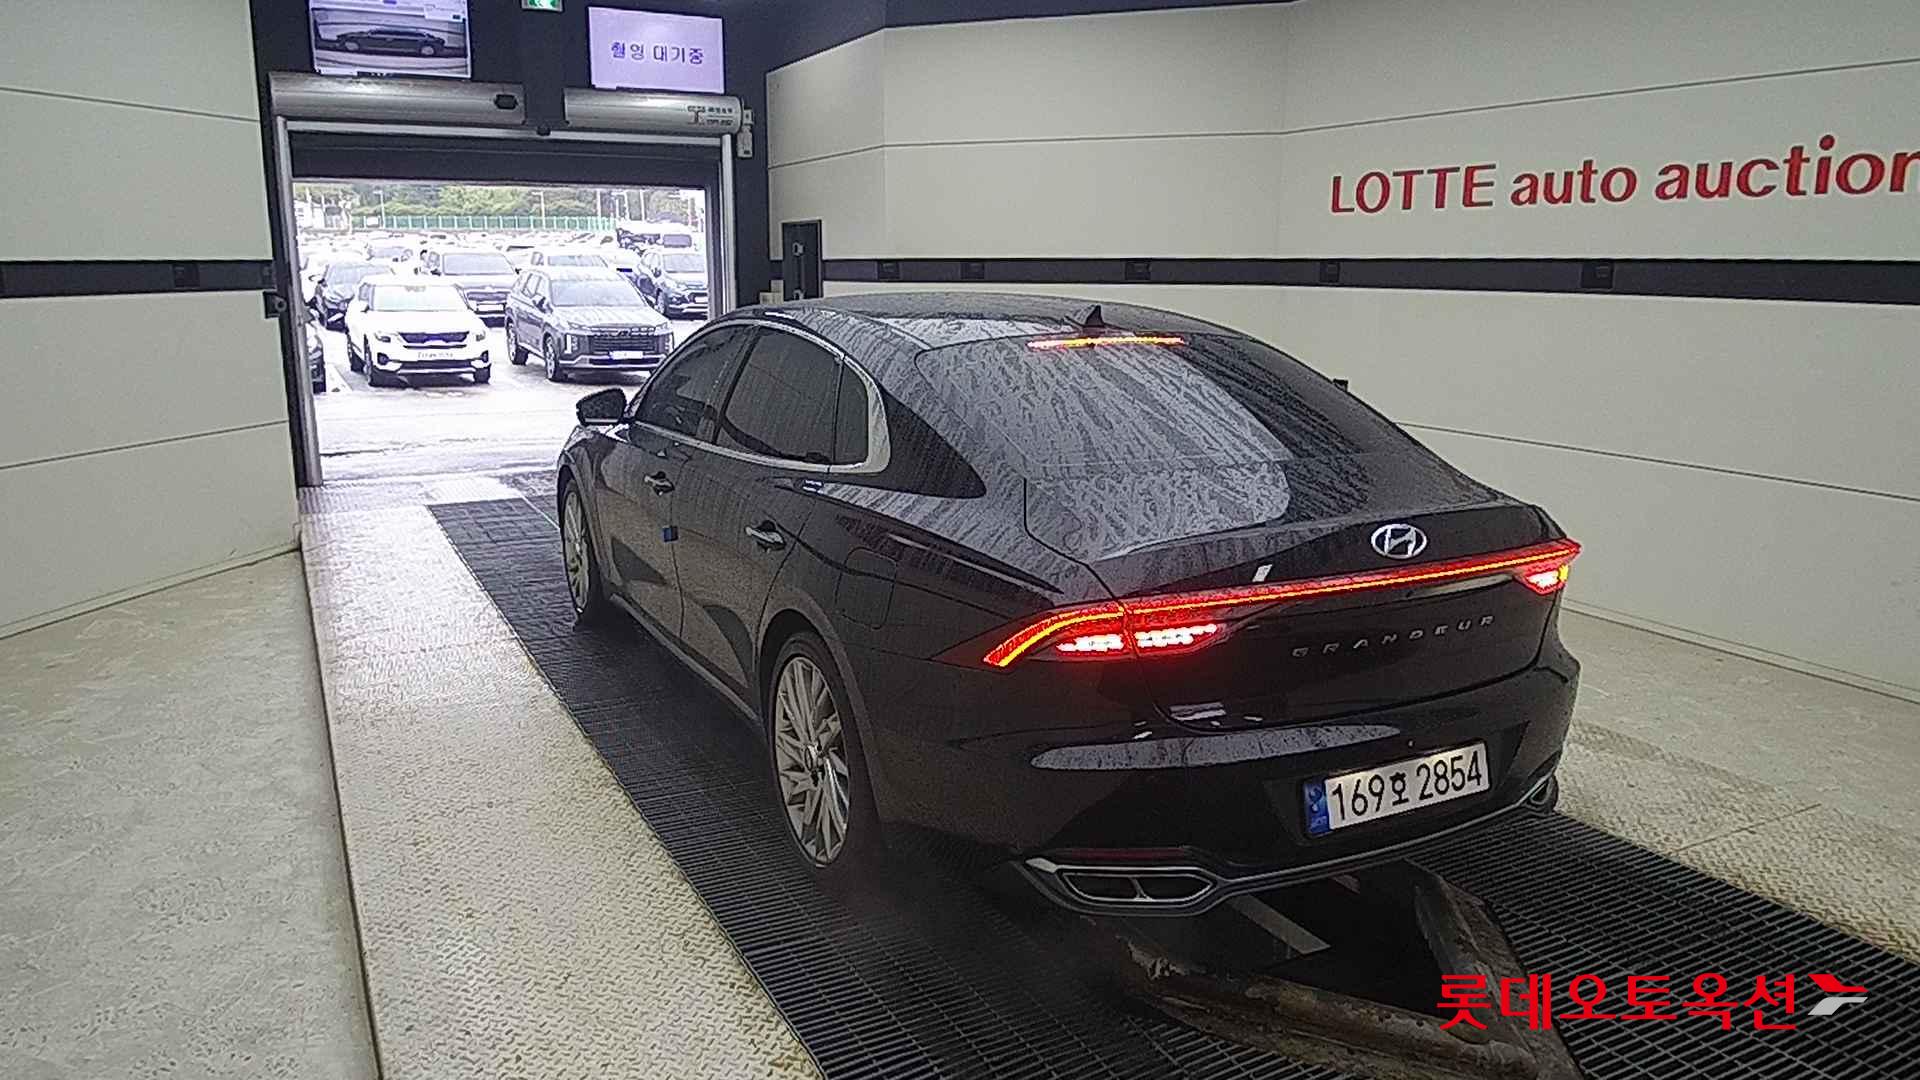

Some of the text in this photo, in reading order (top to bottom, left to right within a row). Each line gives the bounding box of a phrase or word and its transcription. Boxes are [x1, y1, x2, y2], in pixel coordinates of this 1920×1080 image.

[653, 44, 705, 65] 대기중
[1331, 163, 1497, 213] LOTTE
[1511, 159, 1637, 207] auto
[1292, 615, 1495, 656] GRANDEUR
[1332, 752, 1482, 821] 169호 2854
